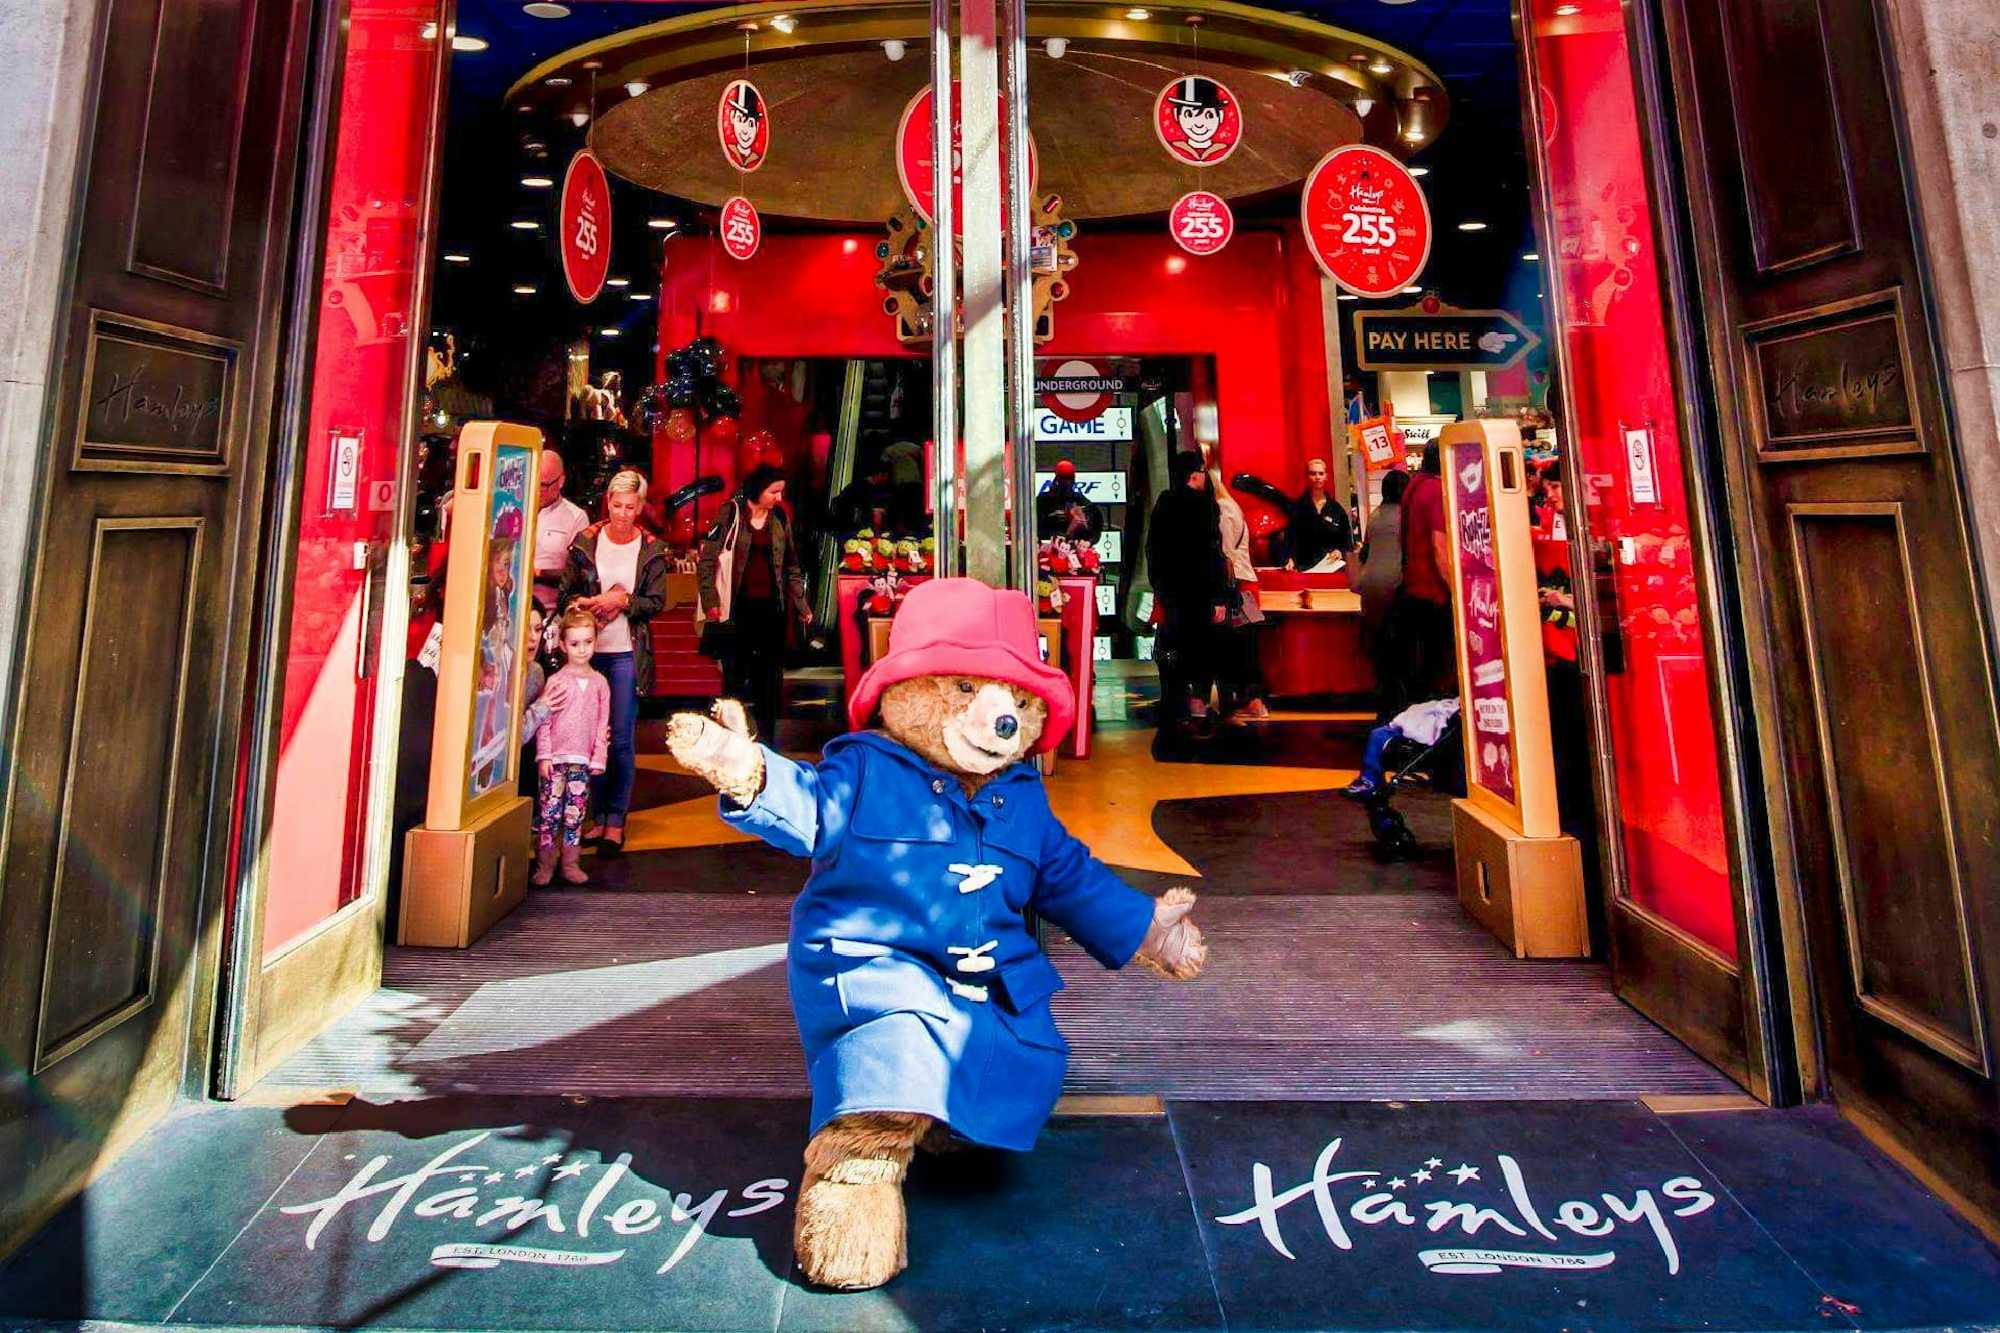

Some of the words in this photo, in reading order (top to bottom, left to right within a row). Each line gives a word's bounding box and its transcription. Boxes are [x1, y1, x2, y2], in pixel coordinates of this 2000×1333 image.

[576, 216, 598, 255] 255
[726, 219, 754, 245] 255
[1180, 217, 1224, 239] 255
[1342, 213, 1397, 247] 255
[1368, 331, 1407, 350] PAY
[1414, 331, 1471, 350] HERE
[1040, 415, 1105, 434] GAME
[1039, 479, 1102, 498] NRF
[280, 1132, 790, 1275] Hamleys
[1214, 1137, 1716, 1276] Hamleys
[489, 1247, 547, 1260] LONDON
[556, 1254, 588, 1263] 1760
[1476, 1253, 1542, 1264] LONDON
[1551, 1257, 1586, 1265] 1760
